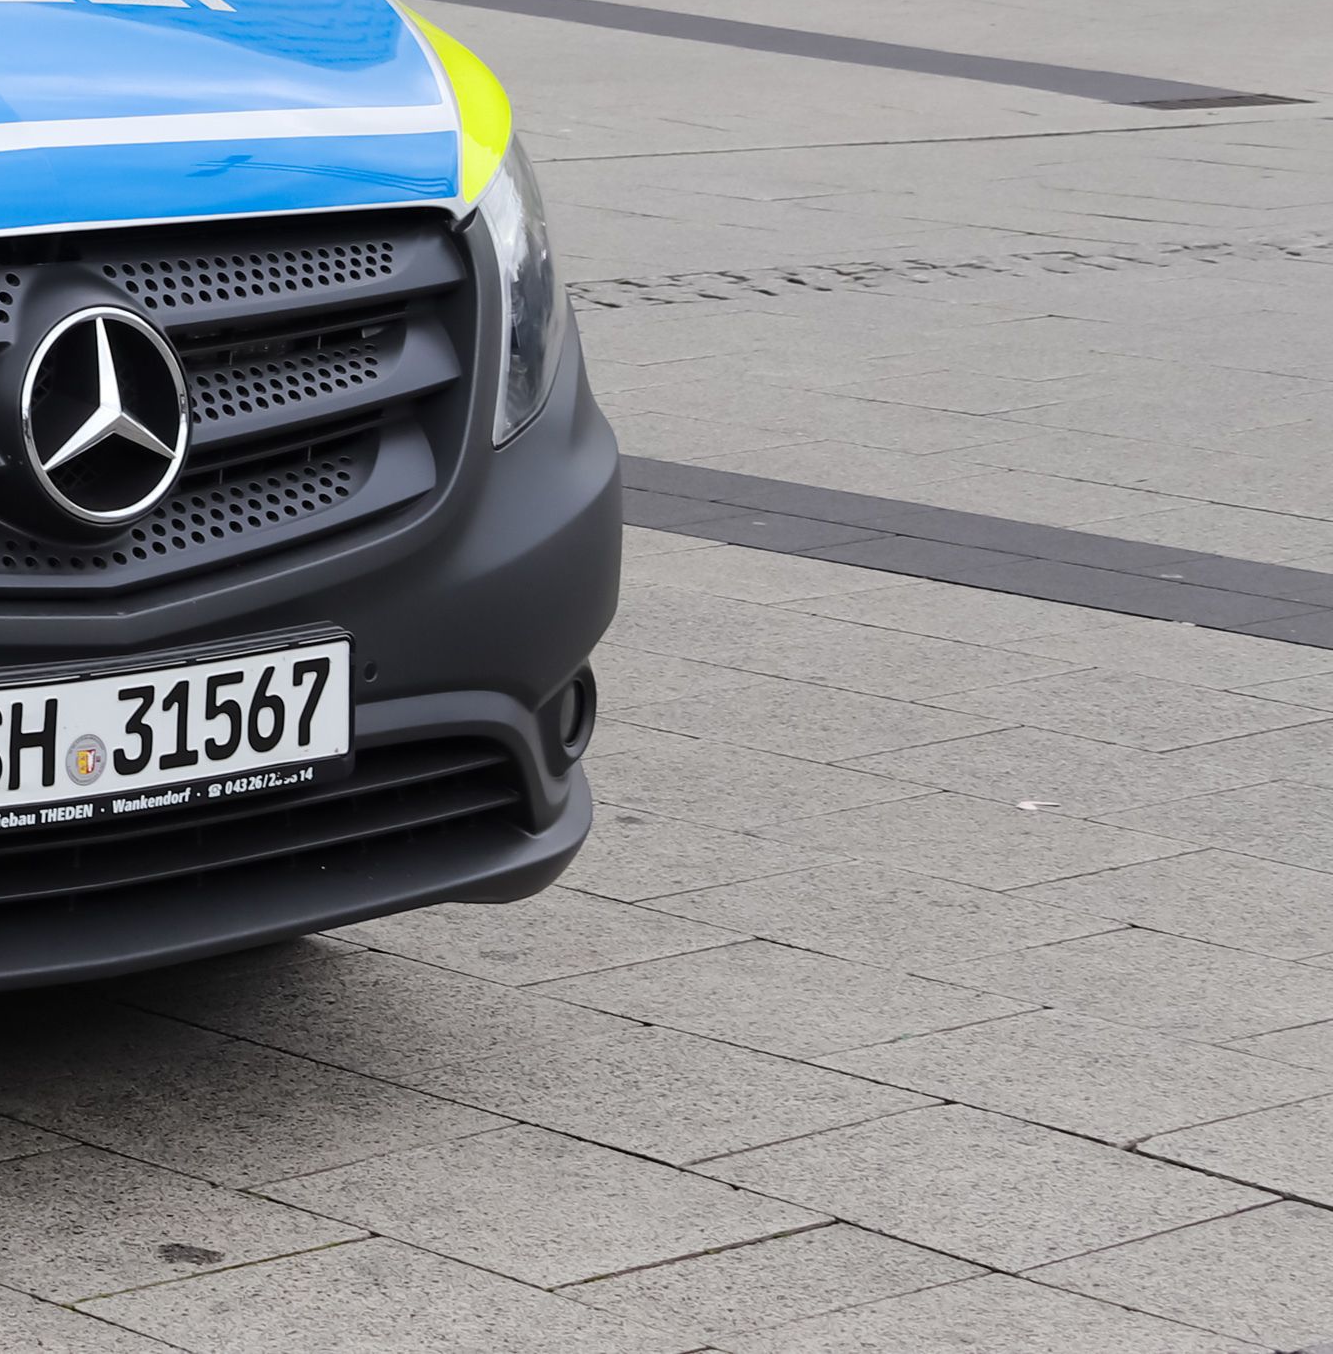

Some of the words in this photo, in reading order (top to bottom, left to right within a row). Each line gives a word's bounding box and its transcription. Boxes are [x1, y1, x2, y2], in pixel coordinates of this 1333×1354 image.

[113, 656, 332, 776] 31567
[39, 803, 94, 824] THEDEN
[112, 787, 192, 815] Wankendorf
